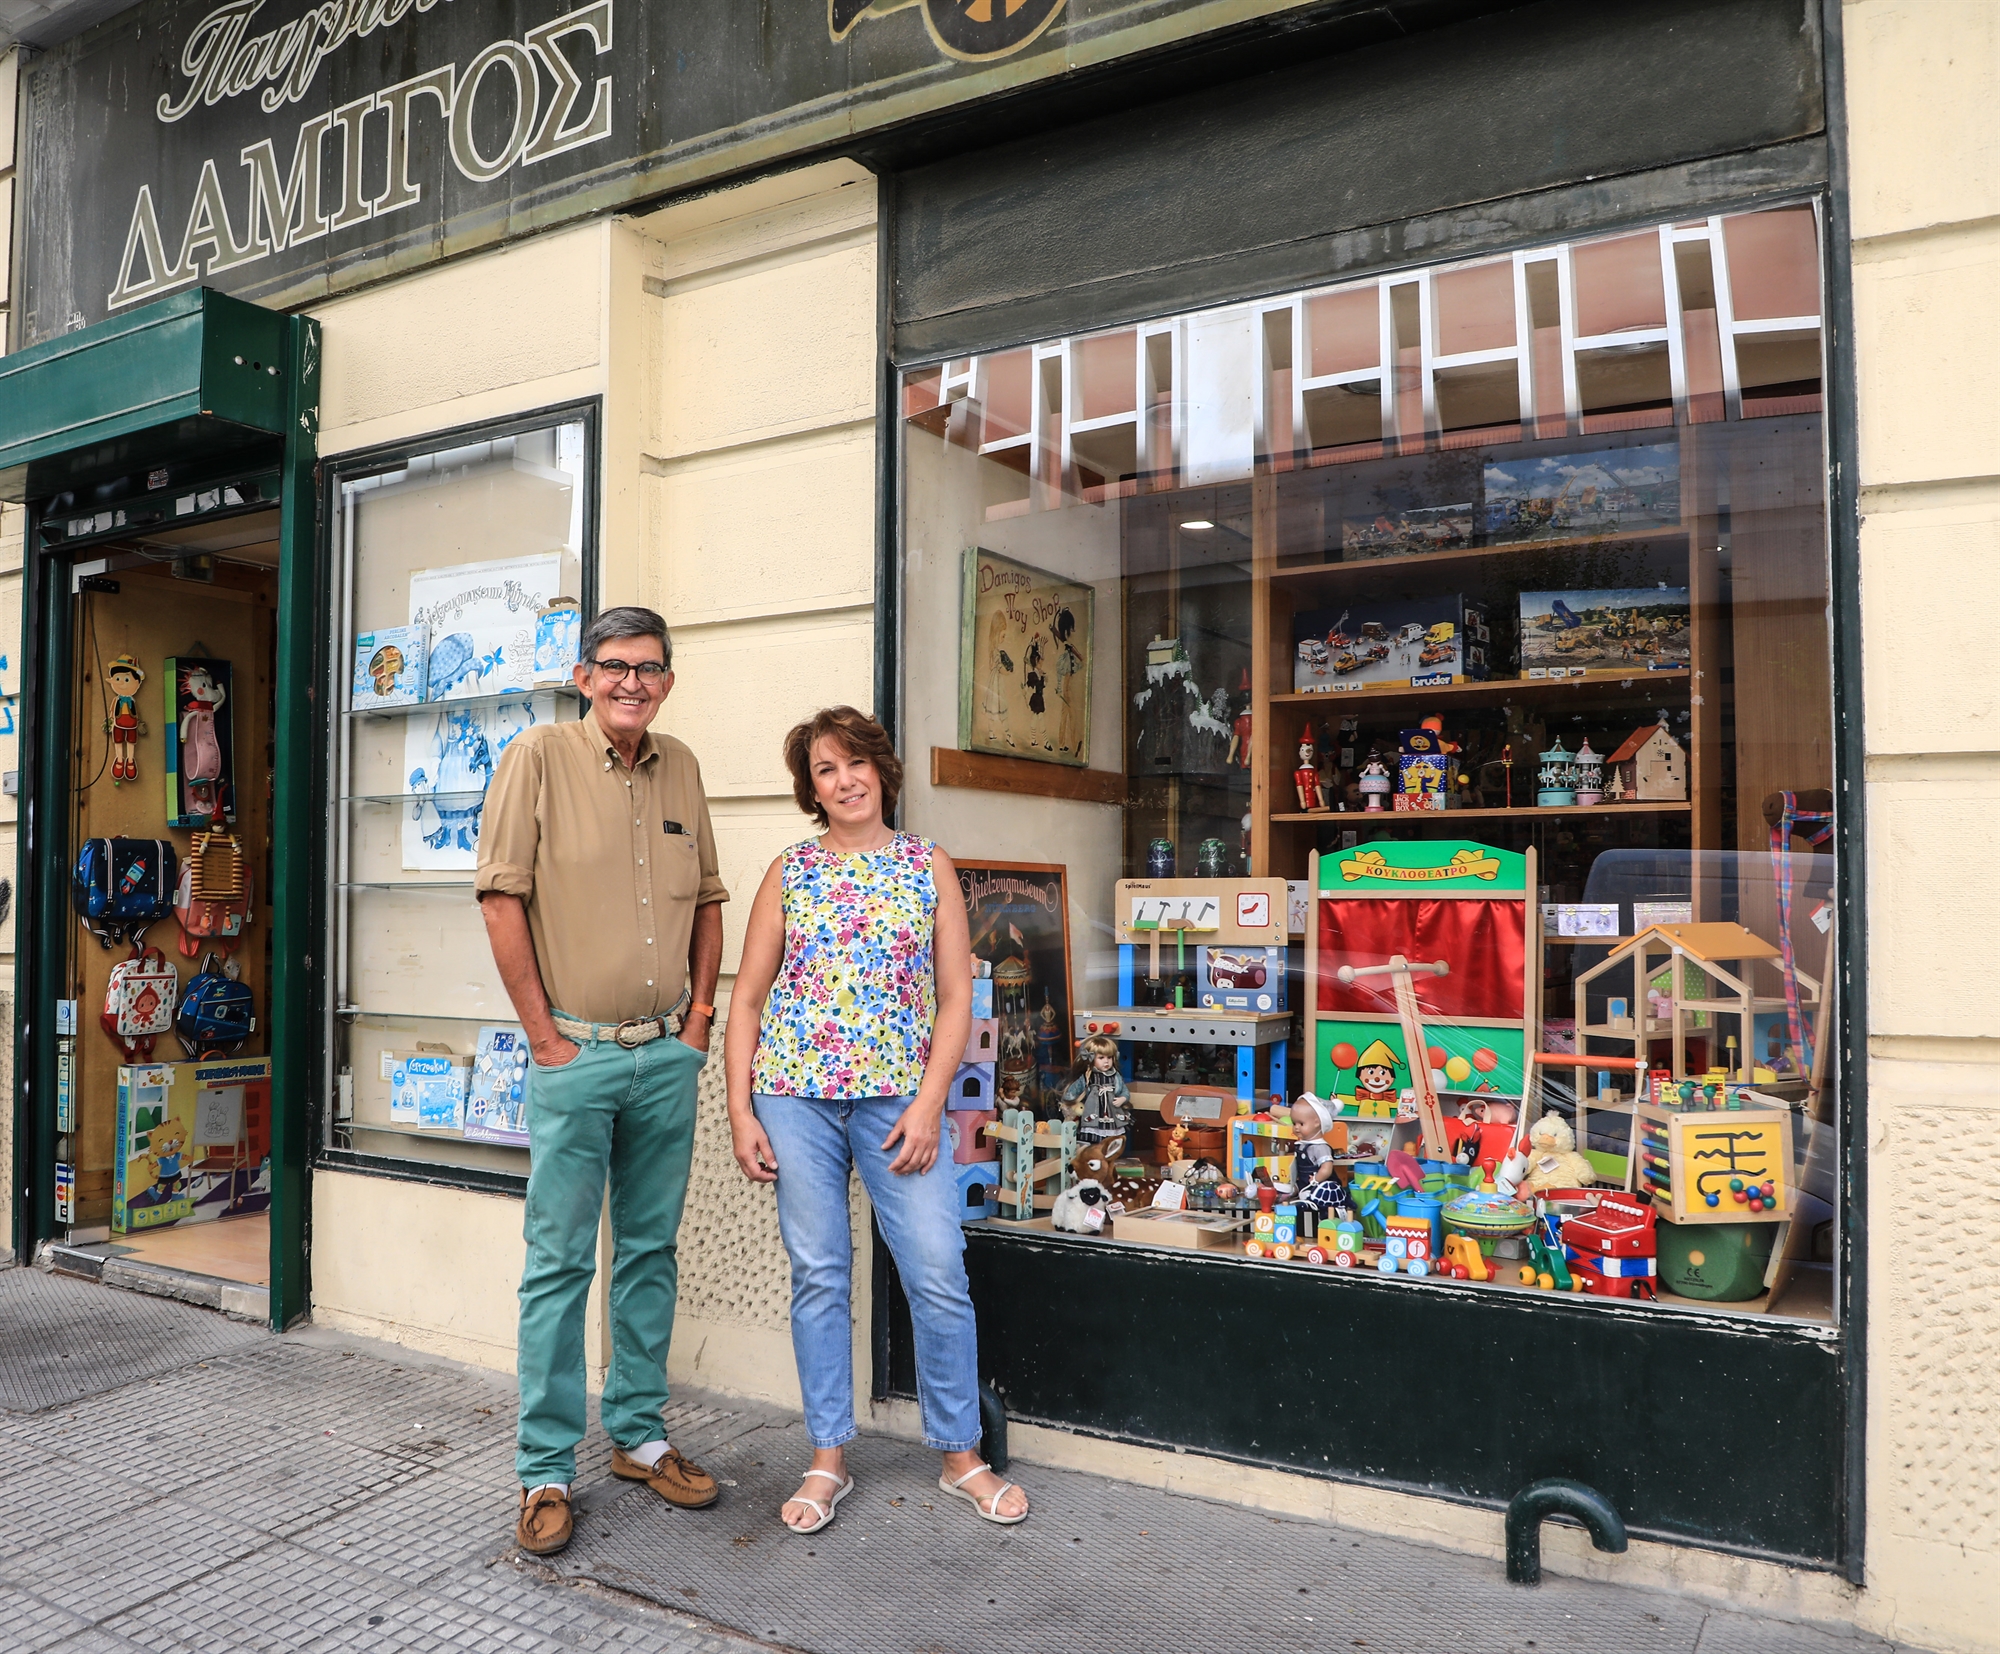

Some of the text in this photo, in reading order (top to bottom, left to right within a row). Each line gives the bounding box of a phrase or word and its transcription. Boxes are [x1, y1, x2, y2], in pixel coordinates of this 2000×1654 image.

[107, 0, 613, 311] ΔΑΜΙΓΟΣ
[978, 564, 1032, 594] Damigos
[1004, 593, 1028, 633] Toy
[1411, 675, 1451, 688] bruder
[1365, 865, 1468, 879] ΚΟΥΚΛΟΘΕΑΤΡΟ
[984, 902, 1036, 913] NÜRNBERG
[1260, 1218, 1288, 1240] p q
[1393, 1242, 1421, 1256] e f
[1687, 1267, 1701, 1278] CE
